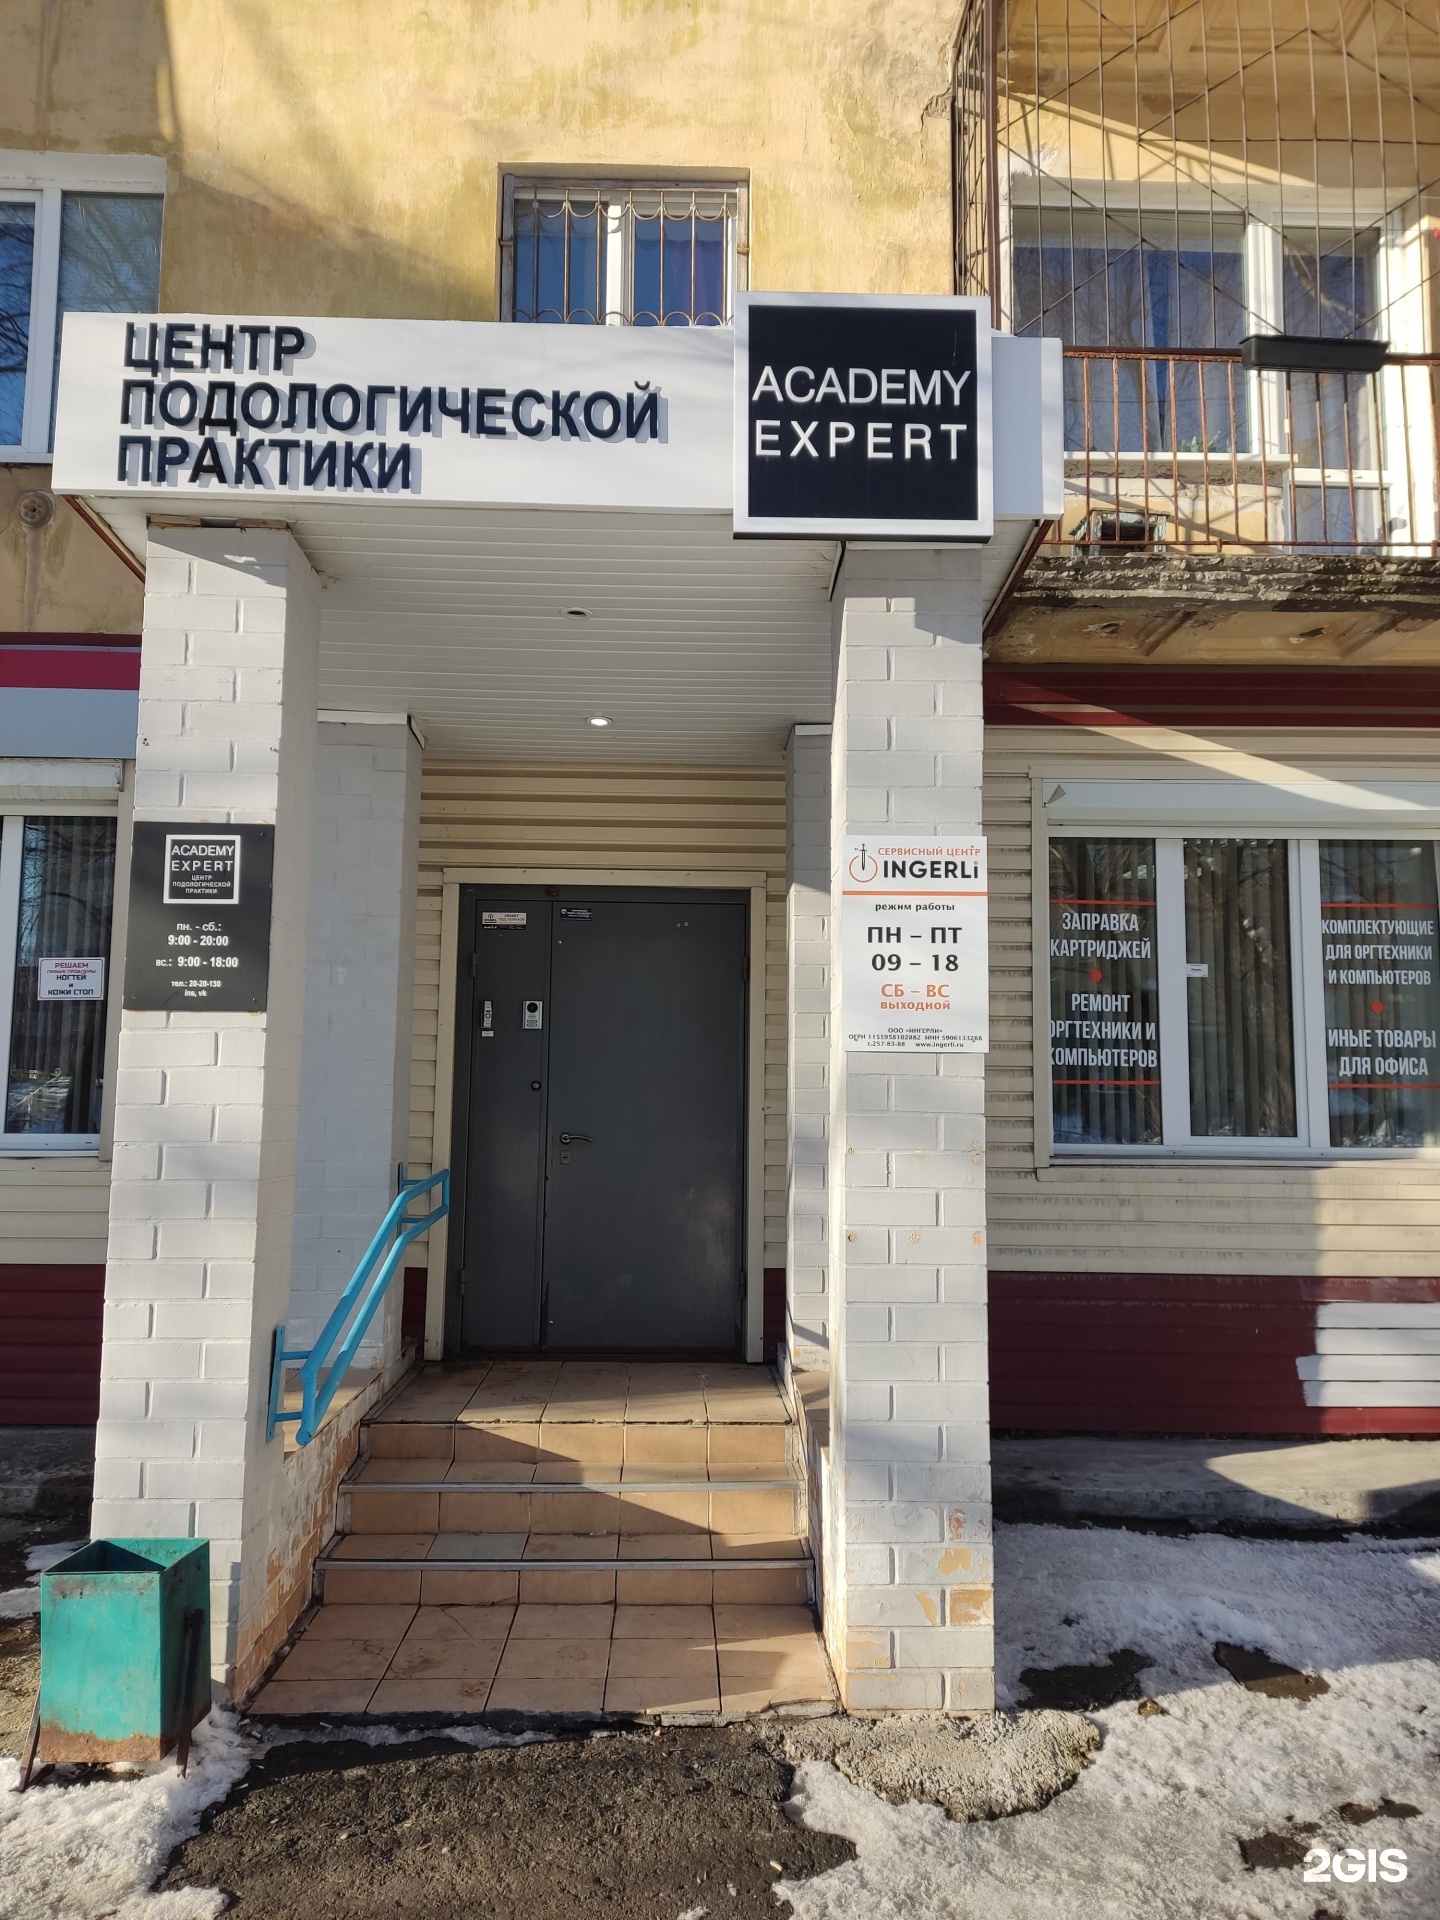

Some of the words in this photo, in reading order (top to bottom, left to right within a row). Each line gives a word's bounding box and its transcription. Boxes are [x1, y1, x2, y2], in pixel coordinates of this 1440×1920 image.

[123, 321, 305, 377] ЦЕНТР
[752, 365, 971, 406] ACADEMY
[120, 378, 658, 440] ПОДОЛОГИЧЕСКОЙ
[755, 419, 967, 460] EXPERT
[117, 435, 411, 489] ПРАКТИКИ
[171, 844, 235, 856] ACADEMY
[877, 846, 943, 856] СЕРВИСНЫЙ
[946, 848, 981, 857] ЦЕНТР
[171, 860, 234, 871] EXPERT
[883, 860, 979, 879] INGERLi
[875, 903, 911, 912] режим
[915, 902, 955, 912] работы
[176, 923, 192, 931] пн.
[202, 922, 222, 931] сб.:
[1062, 912, 1139, 932] ЗАПРАВКА
[1321, 919, 1434, 936] КОМПЛЕКТУЮЩИЕ
[168, 935, 191, 946] 9:00
[200, 935, 229, 946] 20:00
[867, 927, 901, 943] ПН
[930, 927, 962, 944] ПТ
[1050, 937, 1151, 960] КАРТРИДЖЕЙ
[1326, 944, 1351, 961] ДЛЯ
[1354, 944, 1433, 960] ОРГТЕХНИКИ
[155, 958, 172, 967] вс.:
[177, 956, 200, 967] 9:00
[210, 956, 239, 967] 18:00
[871, 953, 901, 972] 09
[932, 953, 959, 972] 18
[1328, 970, 1337, 985] И
[1339, 969, 1431, 985] КОМПЬЮТЕРОВ
[880, 984, 905, 998] СБ
[926, 984, 950, 998] ВС
[880, 1000, 951, 1011] выходной
[1071, 993, 1131, 1012] РЕМОНТ
[1146, 1022, 1156, 1041] И
[1328, 1029, 1372, 1048] ИНЫЕ
[1375, 1029, 1437, 1048] ТОВАРЫ
[915, 1041, 964, 1049] www.ingerli.ru
[1339, 1056, 1371, 1077] ДЛЯ
[1375, 1056, 1429, 1076] ОФИСА
